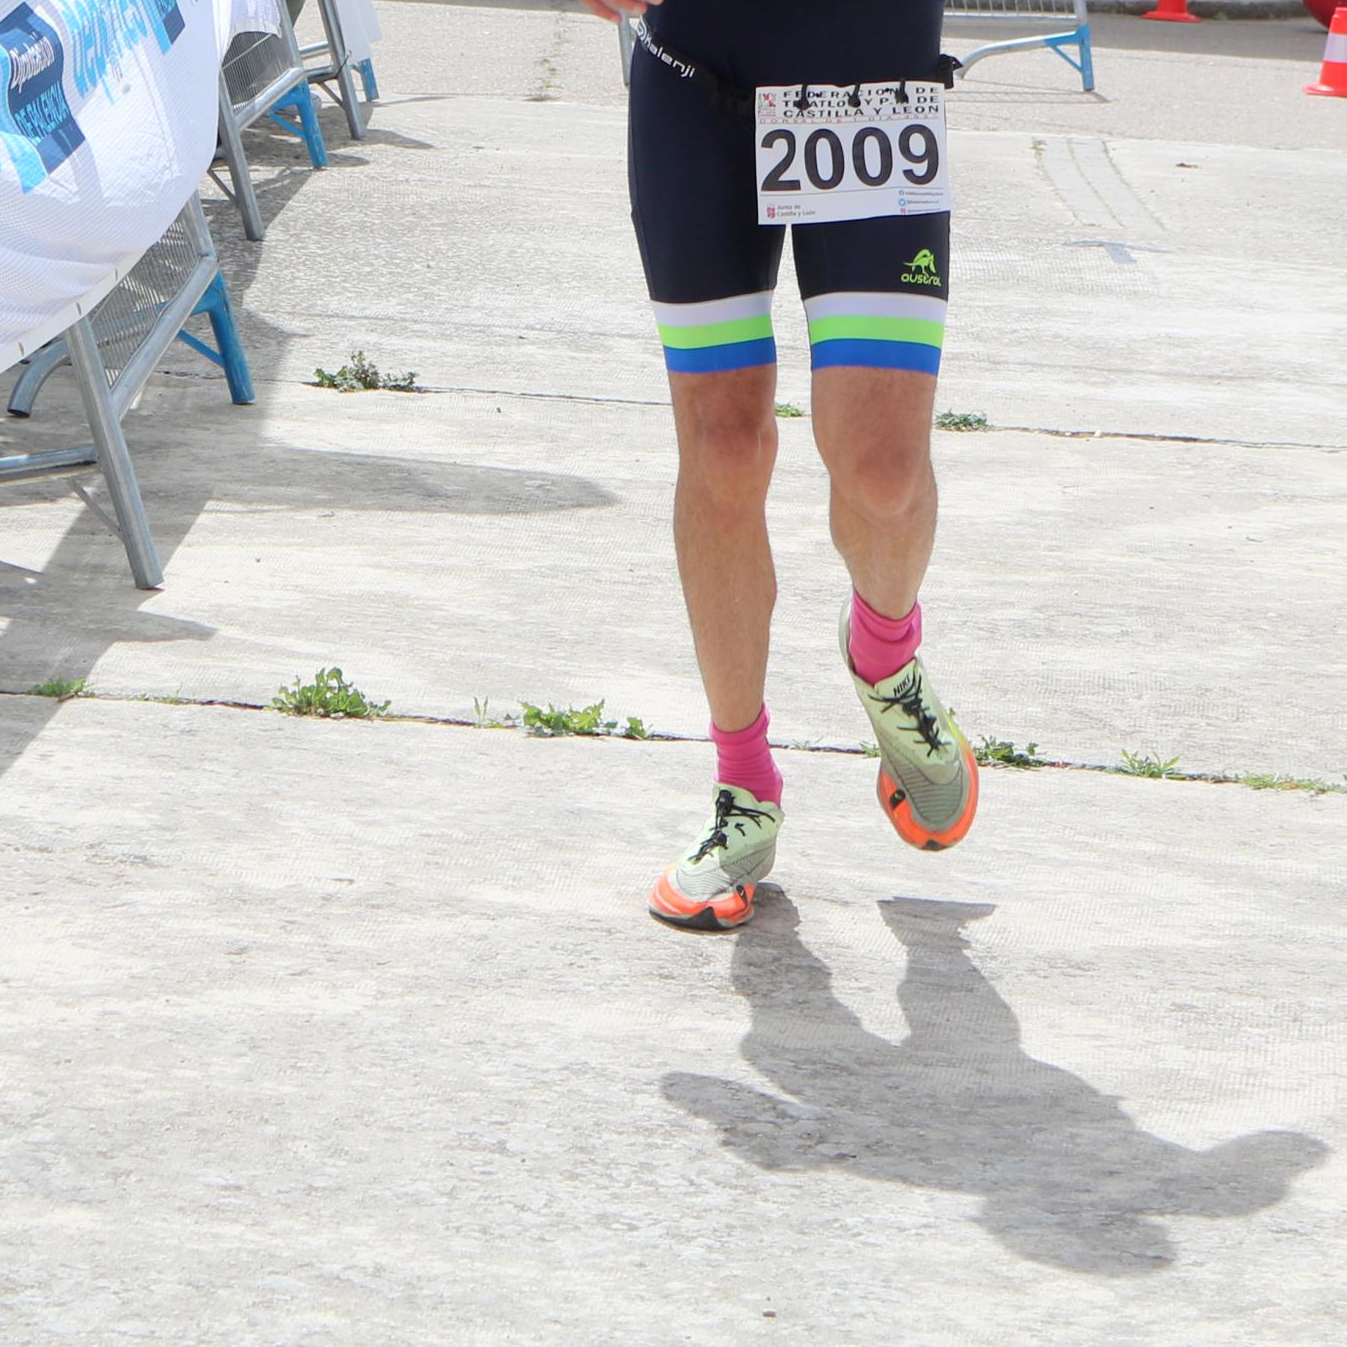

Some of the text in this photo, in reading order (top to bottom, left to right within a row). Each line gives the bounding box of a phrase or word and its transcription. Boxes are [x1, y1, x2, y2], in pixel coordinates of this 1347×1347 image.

[916, 87, 939, 95] DE
[917, 95, 939, 104] DE
[783, 105, 939, 119] CASTILLA Y LEON
[760, 123, 940, 192] 2009
